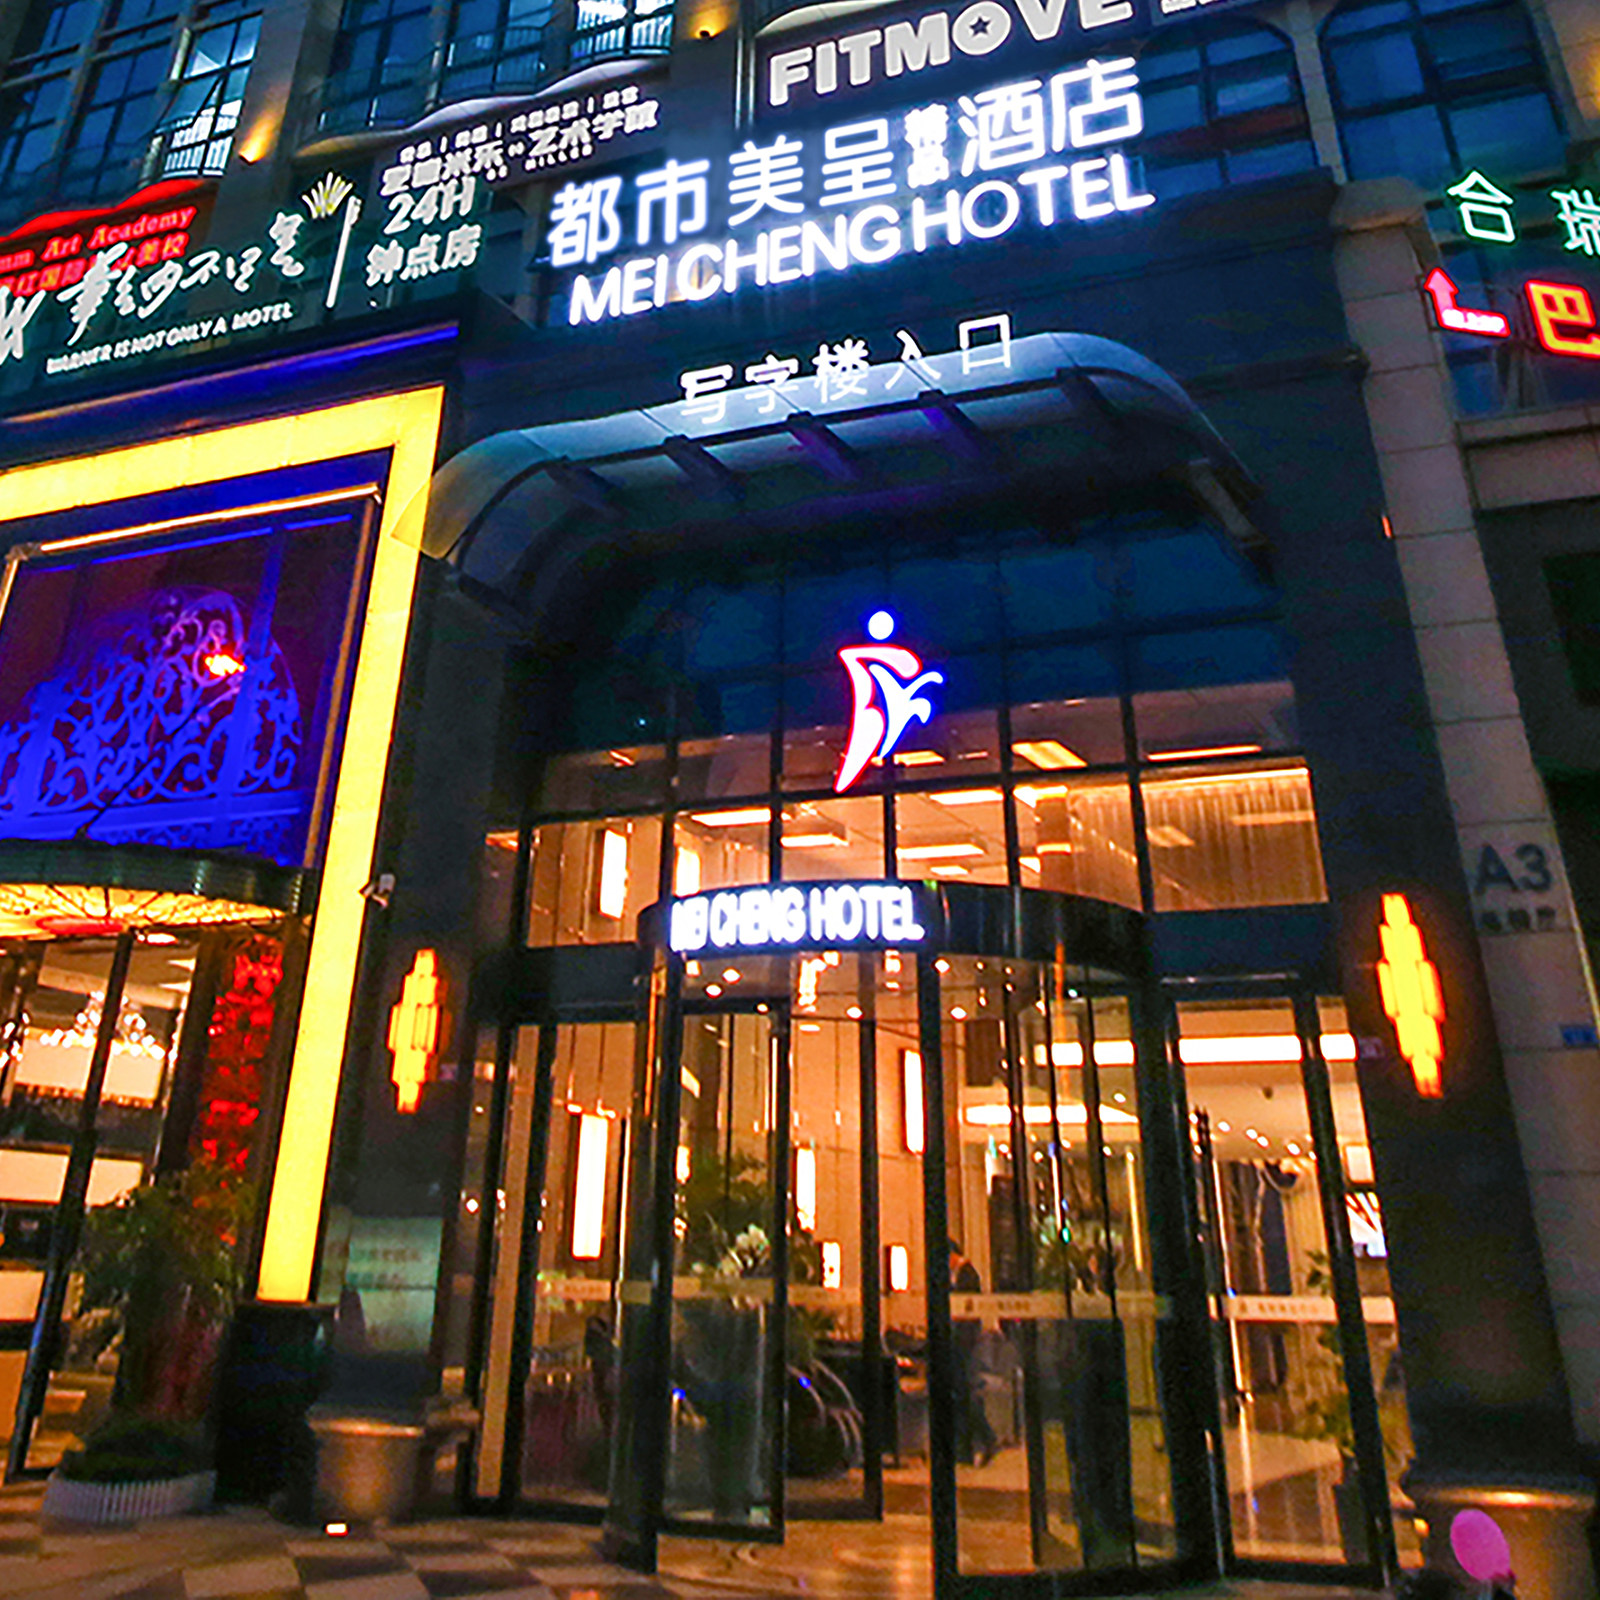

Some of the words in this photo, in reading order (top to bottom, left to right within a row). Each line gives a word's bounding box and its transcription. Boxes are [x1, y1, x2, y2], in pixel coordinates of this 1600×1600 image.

[383, 176, 476, 234] 24H
[912, 152, 1156, 253] HOTEL
[40, 233, 83, 260] Art
[86, 206, 197, 250] Academy
[679, 313, 1013, 425] 写字楼入口
[1473, 842, 1554, 896] A3
[813, 884, 926, 944] HOTEL
